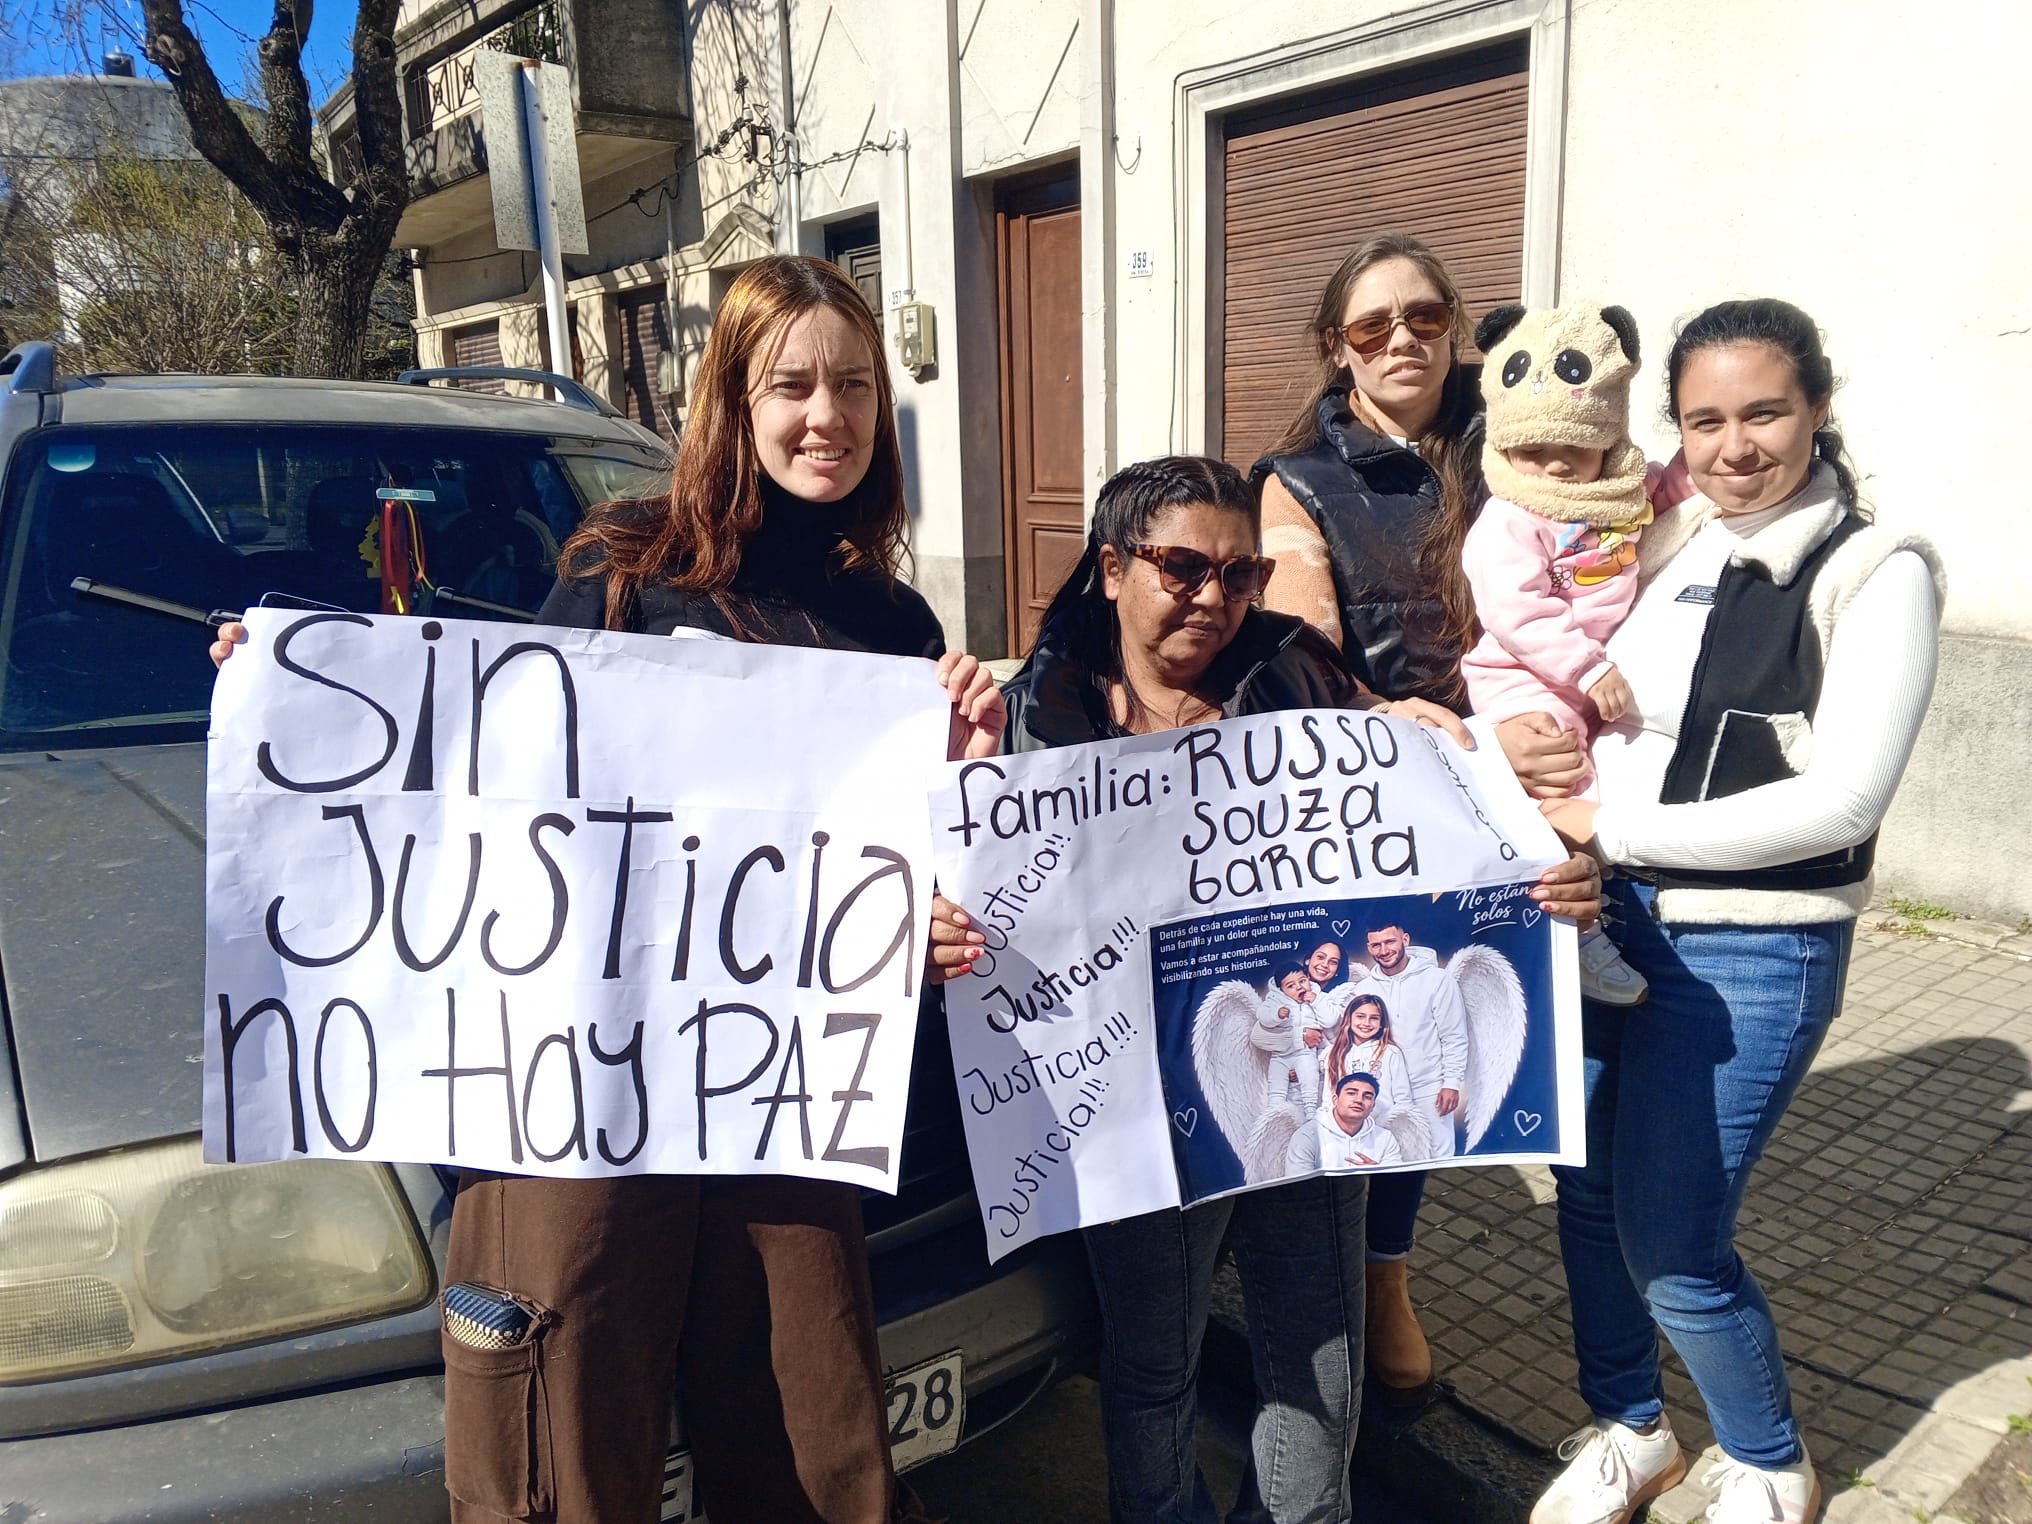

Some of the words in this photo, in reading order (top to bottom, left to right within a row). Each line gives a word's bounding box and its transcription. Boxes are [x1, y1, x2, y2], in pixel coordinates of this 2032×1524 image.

[257, 613, 579, 798] Sin
[948, 756, 1170, 847] familia:
[1174, 715, 1398, 796] RUSSO
[1456, 888, 1486, 911] No
[1489, 884, 1532, 903] están
[1472, 902, 1514, 925] solos
[1160, 928, 1187, 941] Detrás
[1188, 924, 1198, 935] de
[1200, 921, 1220, 932] cada
[1222, 913, 1269, 929] expediente
[1270, 910, 1286, 921] hay
[1288, 910, 1305, 919] una
[1306, 906, 1329, 918] vida,
[1160, 944, 1176, 953] una
[1177, 937, 1206, 951] familia
[1206, 937, 1213, 947] y
[1214, 934, 1225, 943] un
[1227, 928, 1249, 940] dolor
[1251, 928, 1267, 939] que
[1269, 925, 1281, 934] no
[1282, 920, 1320, 932] termina.
[1160, 958, 1188, 971] Vamos
[1190, 957, 1196, 965] a
[1198, 953, 1219, 964] estar
[1293, 941, 1300, 950] y
[1161, 967, 1213, 984] visibilizando
[1214, 965, 1230, 974] sus
[1231, 958, 1271, 972] historias.
[218, 994, 378, 1162] no
[421, 988, 648, 1165] Hay
[679, 998, 889, 1174] PAZ
